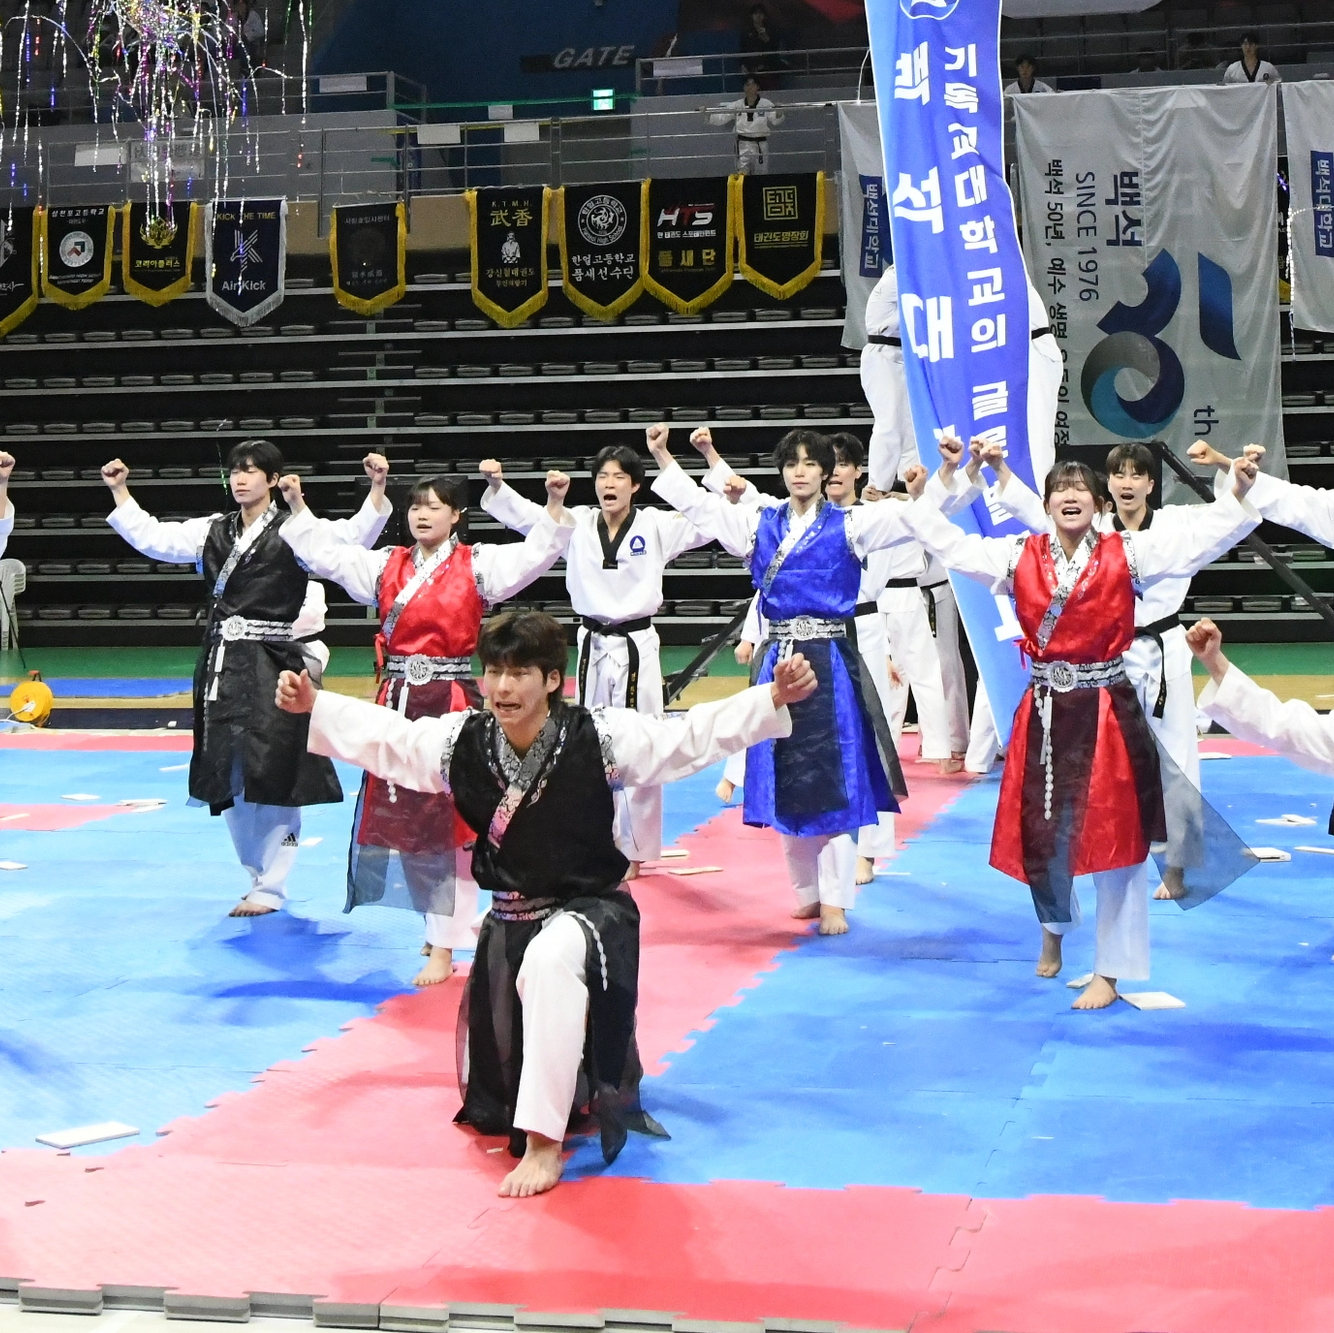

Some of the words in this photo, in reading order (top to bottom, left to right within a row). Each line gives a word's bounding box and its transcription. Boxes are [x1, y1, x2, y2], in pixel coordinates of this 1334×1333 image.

[551, 44, 637, 70] GATE
[1044, 159, 1064, 195] 백석
[216, 213, 236, 221] KICK
[257, 211, 277, 219] TIME
[656, 202, 716, 228] HTS
[1044, 201, 1065, 247] 50년,
[1076, 172, 1097, 239] SINCE
[1105, 171, 1143, 247] 백석
[1315, 159, 1334, 250] 백석대학교
[892, 41, 961, 442] 백석대
[1047, 257, 1066, 295] 예수
[1078, 247, 1100, 302] 1976
[1194, 405, 1219, 436] th
